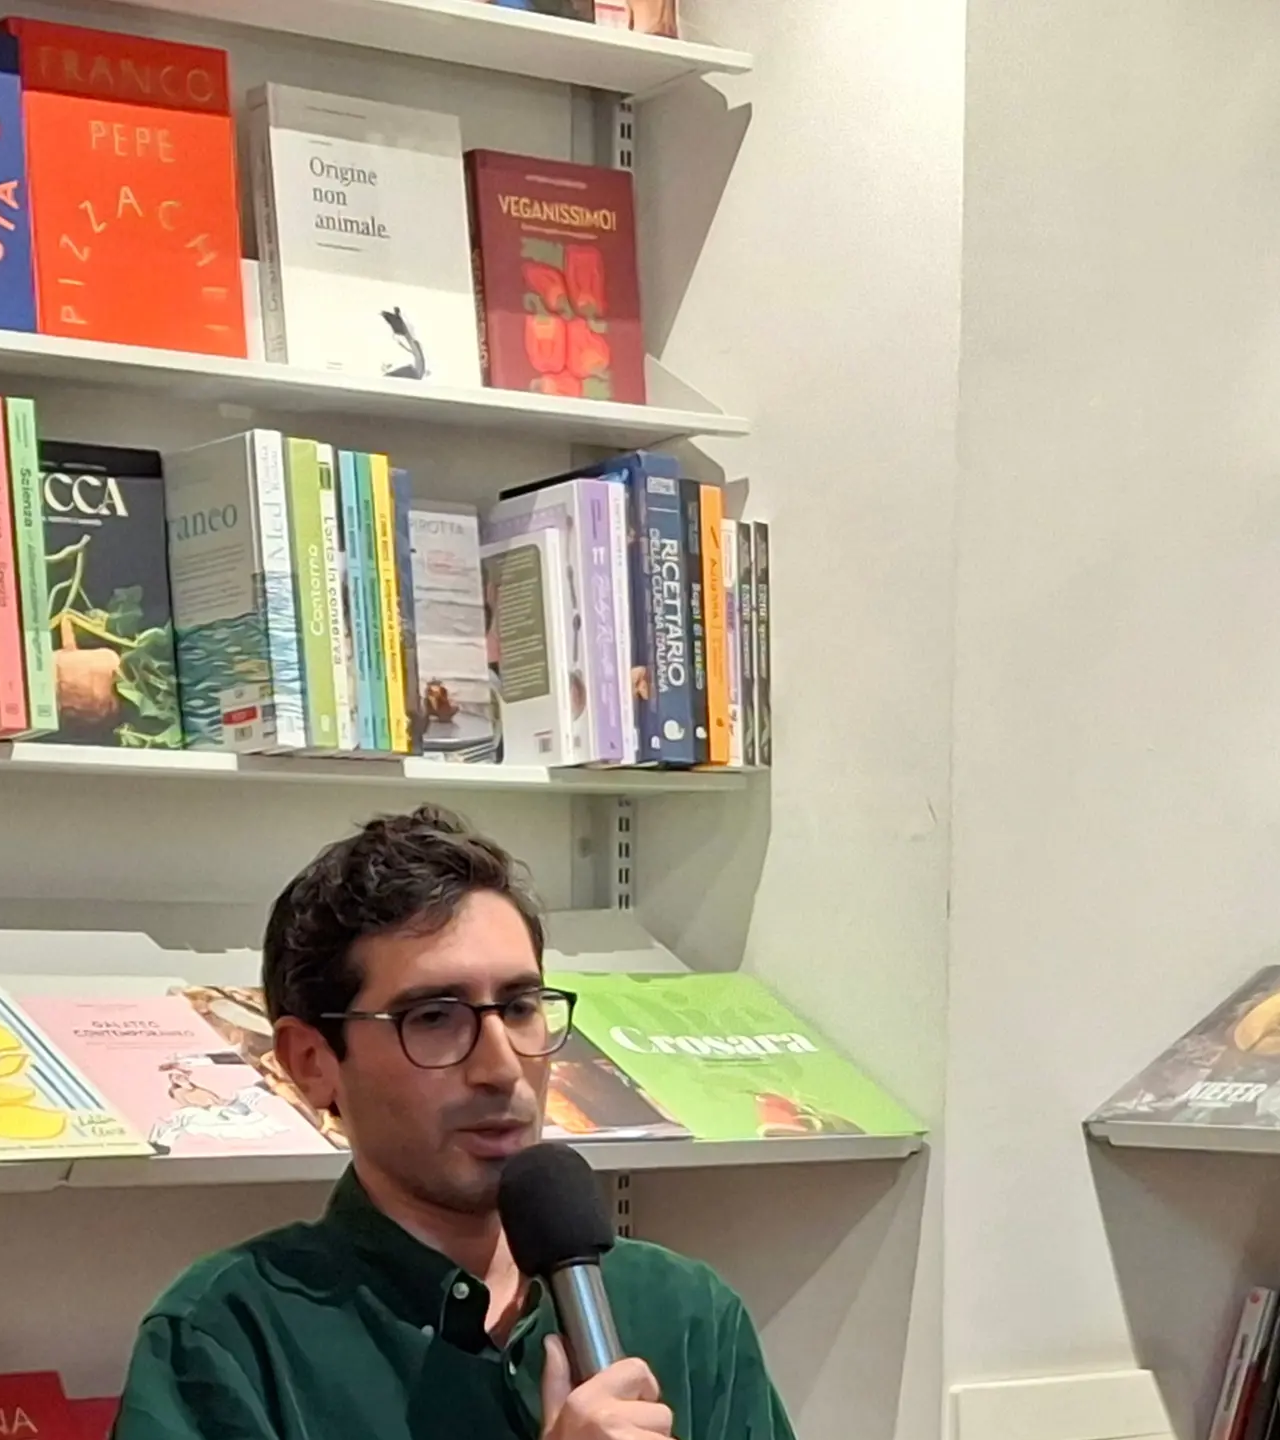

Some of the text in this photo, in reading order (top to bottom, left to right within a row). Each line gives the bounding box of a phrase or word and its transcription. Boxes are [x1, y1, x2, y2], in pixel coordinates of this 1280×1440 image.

[36, 45, 216, 102] FRANCO
[88, 119, 177, 163] PEPE
[309, 156, 377, 187] Origine
[312, 187, 347, 206] non
[497, 193, 617, 231] VEGANISSIMO!
[20, 467, 35, 528] Scienza
[176, 503, 238, 542] aneo
[309, 544, 327, 638] Contorno
[652, 575, 665, 629] CUCINA
[660, 537, 686, 688] RICETTARIO
[327, 587, 343, 665] conserva
[655, 631, 669, 693] ITALIANA
[608, 1024, 820, 1056] Crosara
[1185, 1080, 1269, 1104] KIEFER
